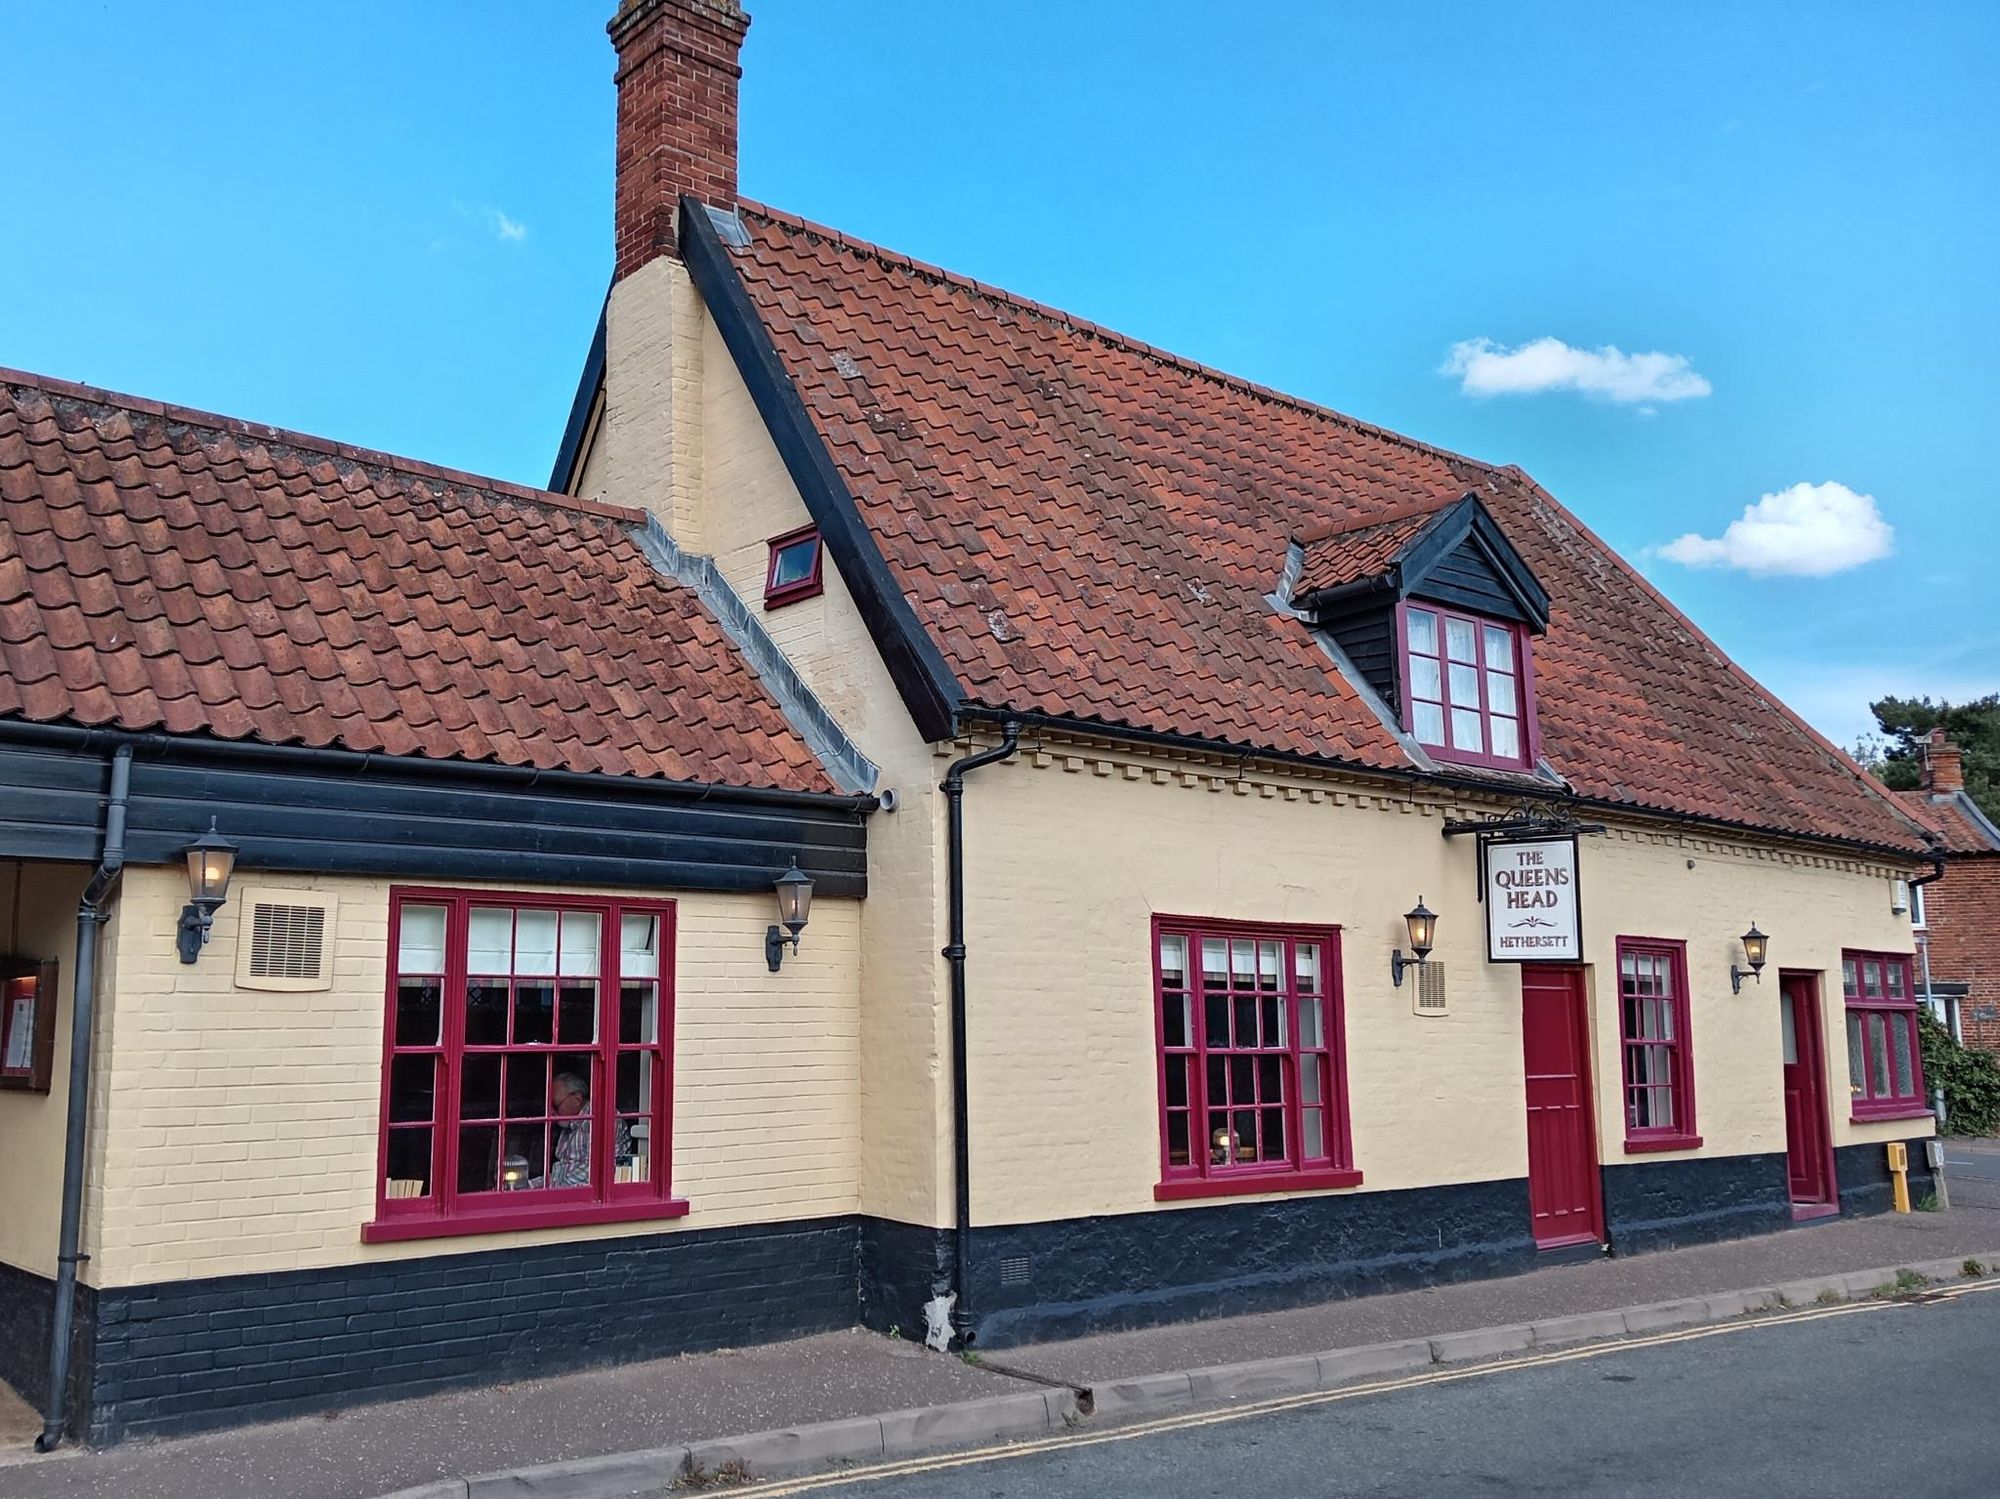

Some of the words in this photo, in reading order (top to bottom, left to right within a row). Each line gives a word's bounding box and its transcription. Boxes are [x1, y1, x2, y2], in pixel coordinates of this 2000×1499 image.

[1517, 851, 1544, 866] THE
[1495, 867, 1569, 890] QUEENS
[1507, 890, 1558, 909] HEAD
[1500, 935, 1568, 948] HETHERSETT
